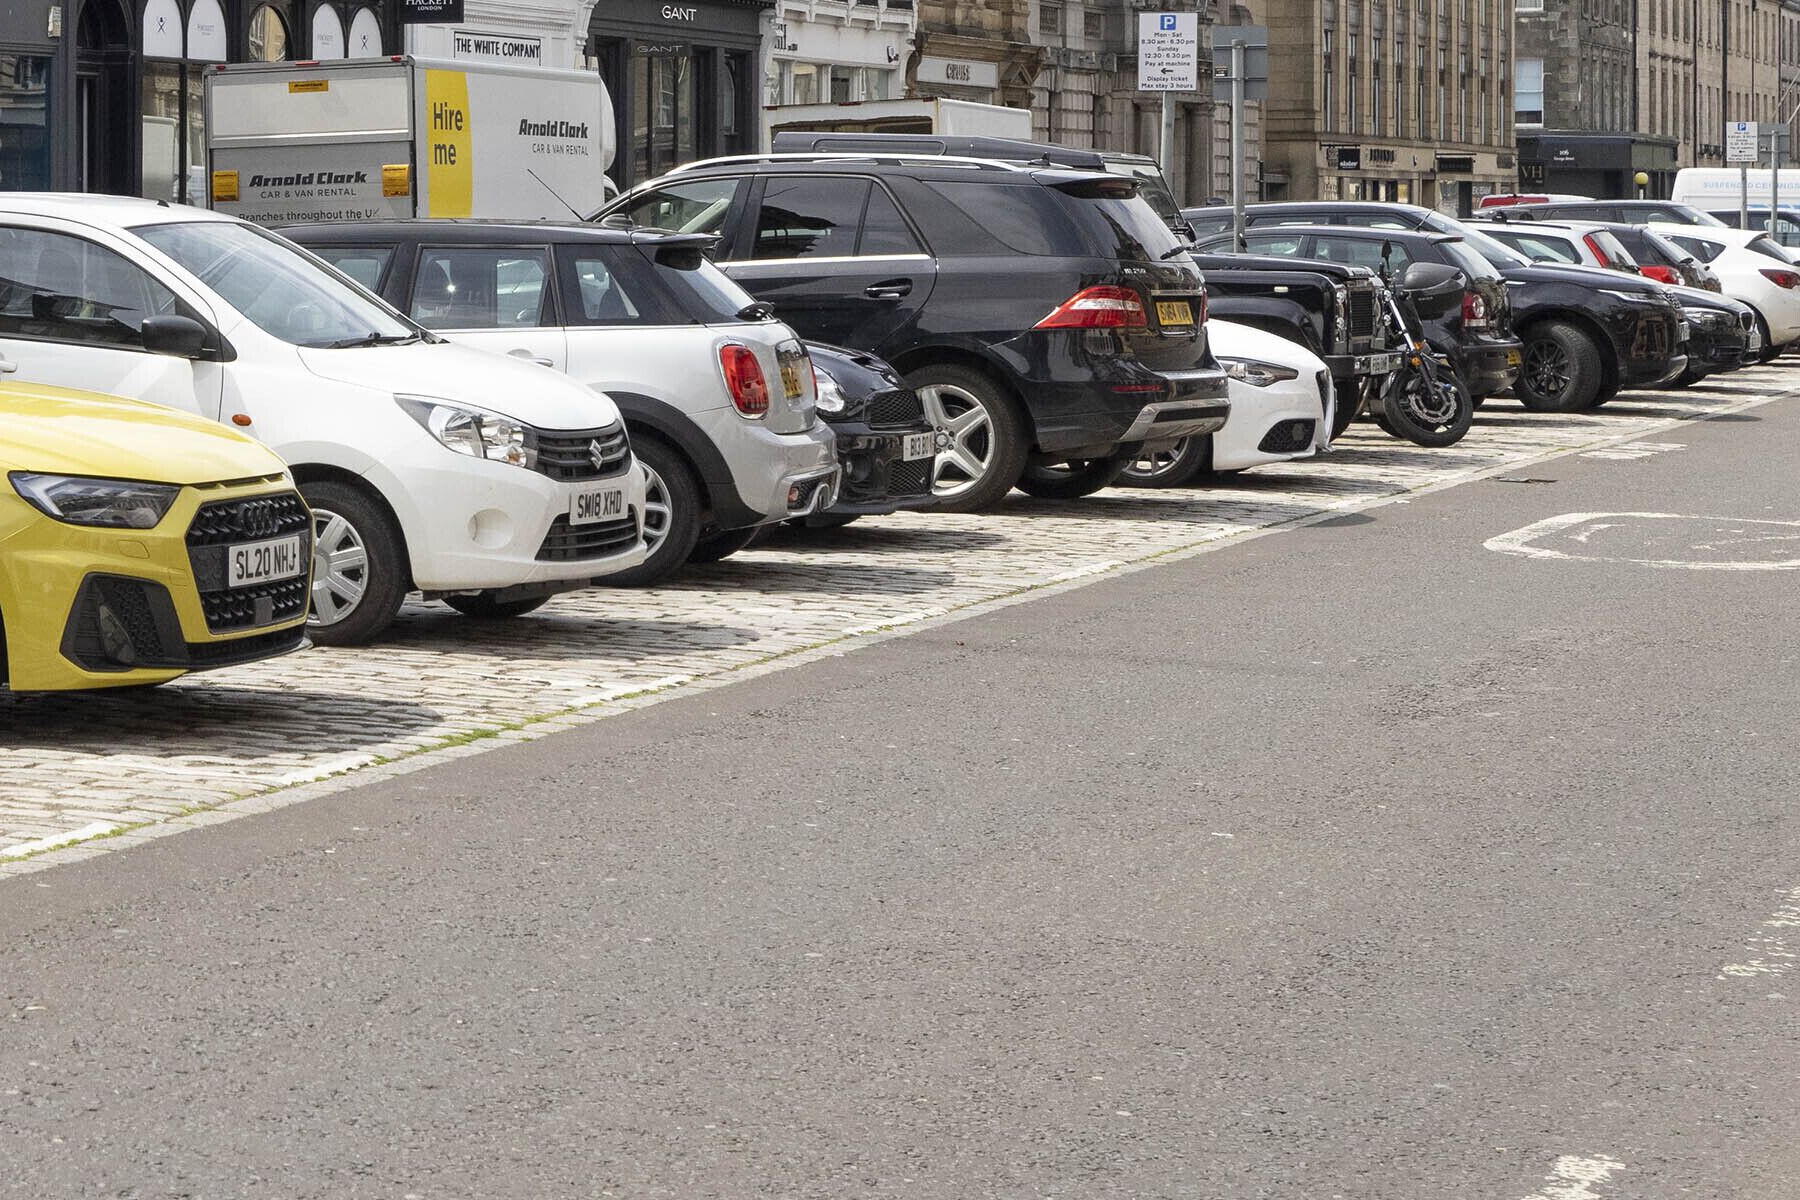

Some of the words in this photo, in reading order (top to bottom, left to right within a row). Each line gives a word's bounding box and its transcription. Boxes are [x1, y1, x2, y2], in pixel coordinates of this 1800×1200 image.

[662, 5, 696, 21] GANT
[1164, 17, 1174, 29] P
[456, 38, 472, 53] THE
[474, 40, 500, 56] WHITE
[502, 42, 540, 58] COMPANY
[637, 45, 684, 53] GANT
[433, 102, 463, 131] Hire
[519, 118, 558, 137] Arnold
[559, 122, 588, 139] Clark
[434, 143, 456, 165] me
[532, 143, 545, 154] CAR
[546, 144, 551, 154] &
[553, 144, 565, 154] VAN
[566, 145, 589, 156] RENTAL
[249, 172, 315, 188] Arnold
[317, 171, 368, 185] Clark
[261, 191, 280, 199] CAR
[285, 190, 291, 198] &
[295, 190, 314, 198] VAN
[318, 189, 357, 197] RENTAL
[239, 211, 284, 222] Branches
[287, 209, 343, 221] throughout
[346, 209, 362, 219] the
[578, 493, 601, 518] SM18
[603, 490, 622, 516] XHD
[236, 547, 270, 580] SL20
[274, 542, 296, 574] NHJ
